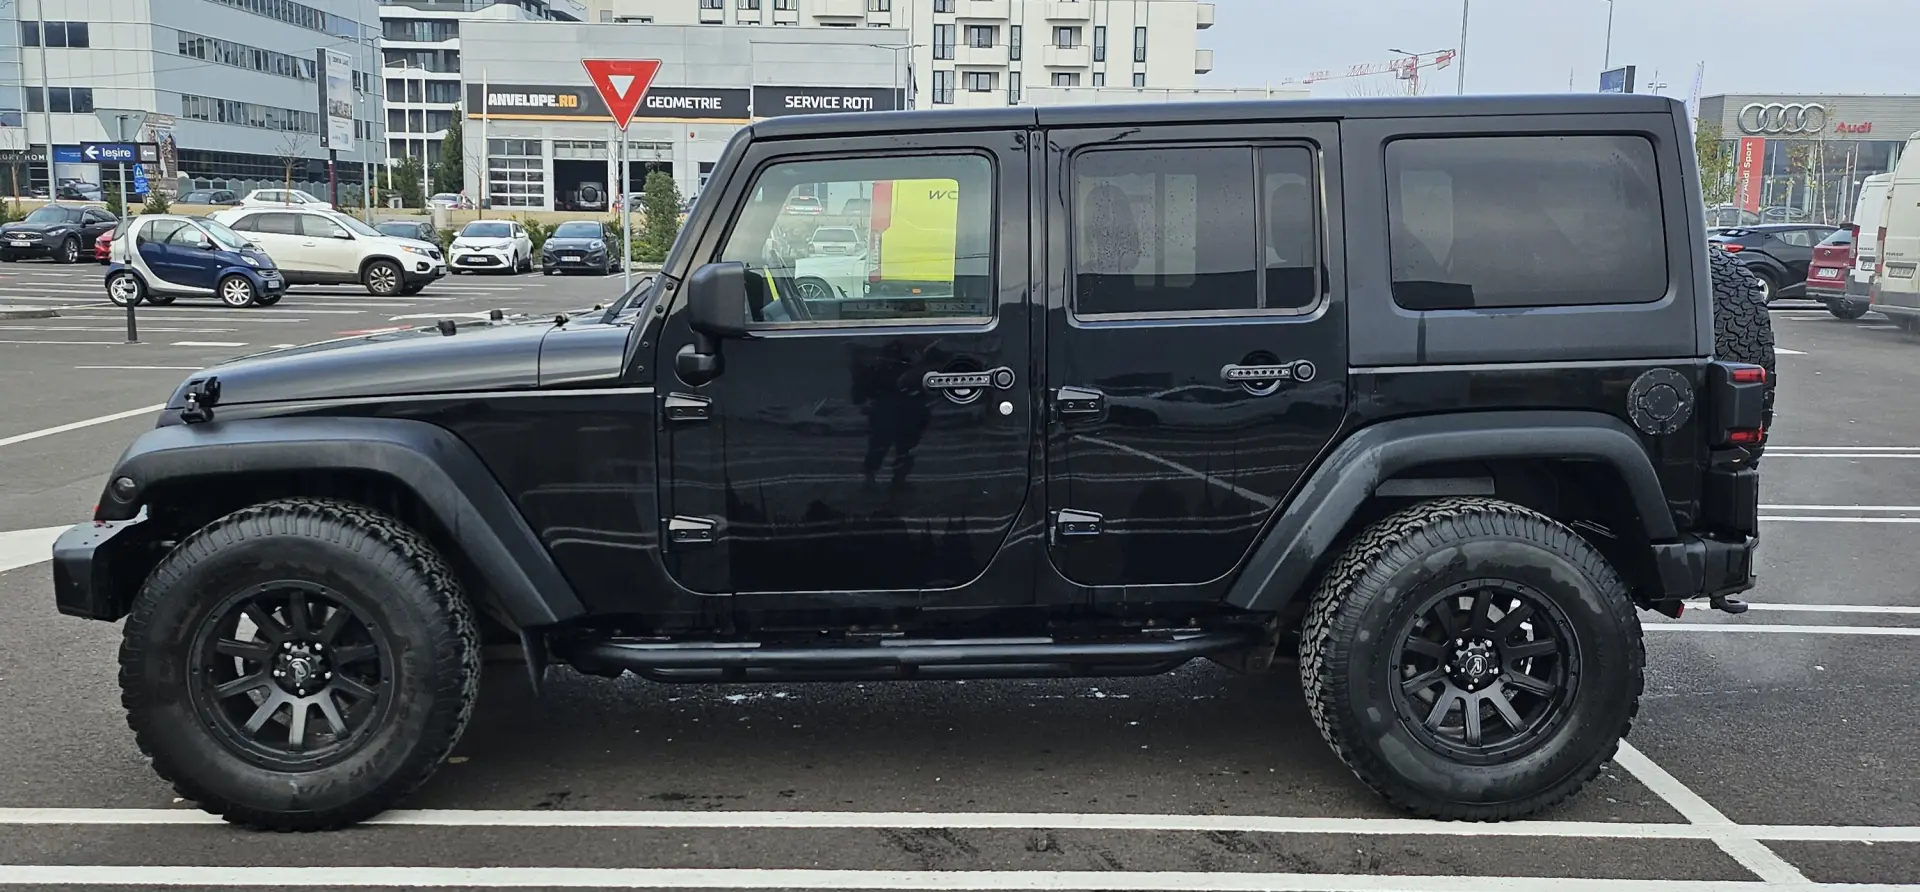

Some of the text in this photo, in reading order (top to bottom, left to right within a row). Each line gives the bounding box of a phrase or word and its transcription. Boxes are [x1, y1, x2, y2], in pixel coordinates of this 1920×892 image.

[646, 95, 722, 110] GEOMETRIE
[785, 95, 840, 109] SERVICE
[1835, 122, 1873, 134] Audi
[1743, 141, 1753, 168] Sport
